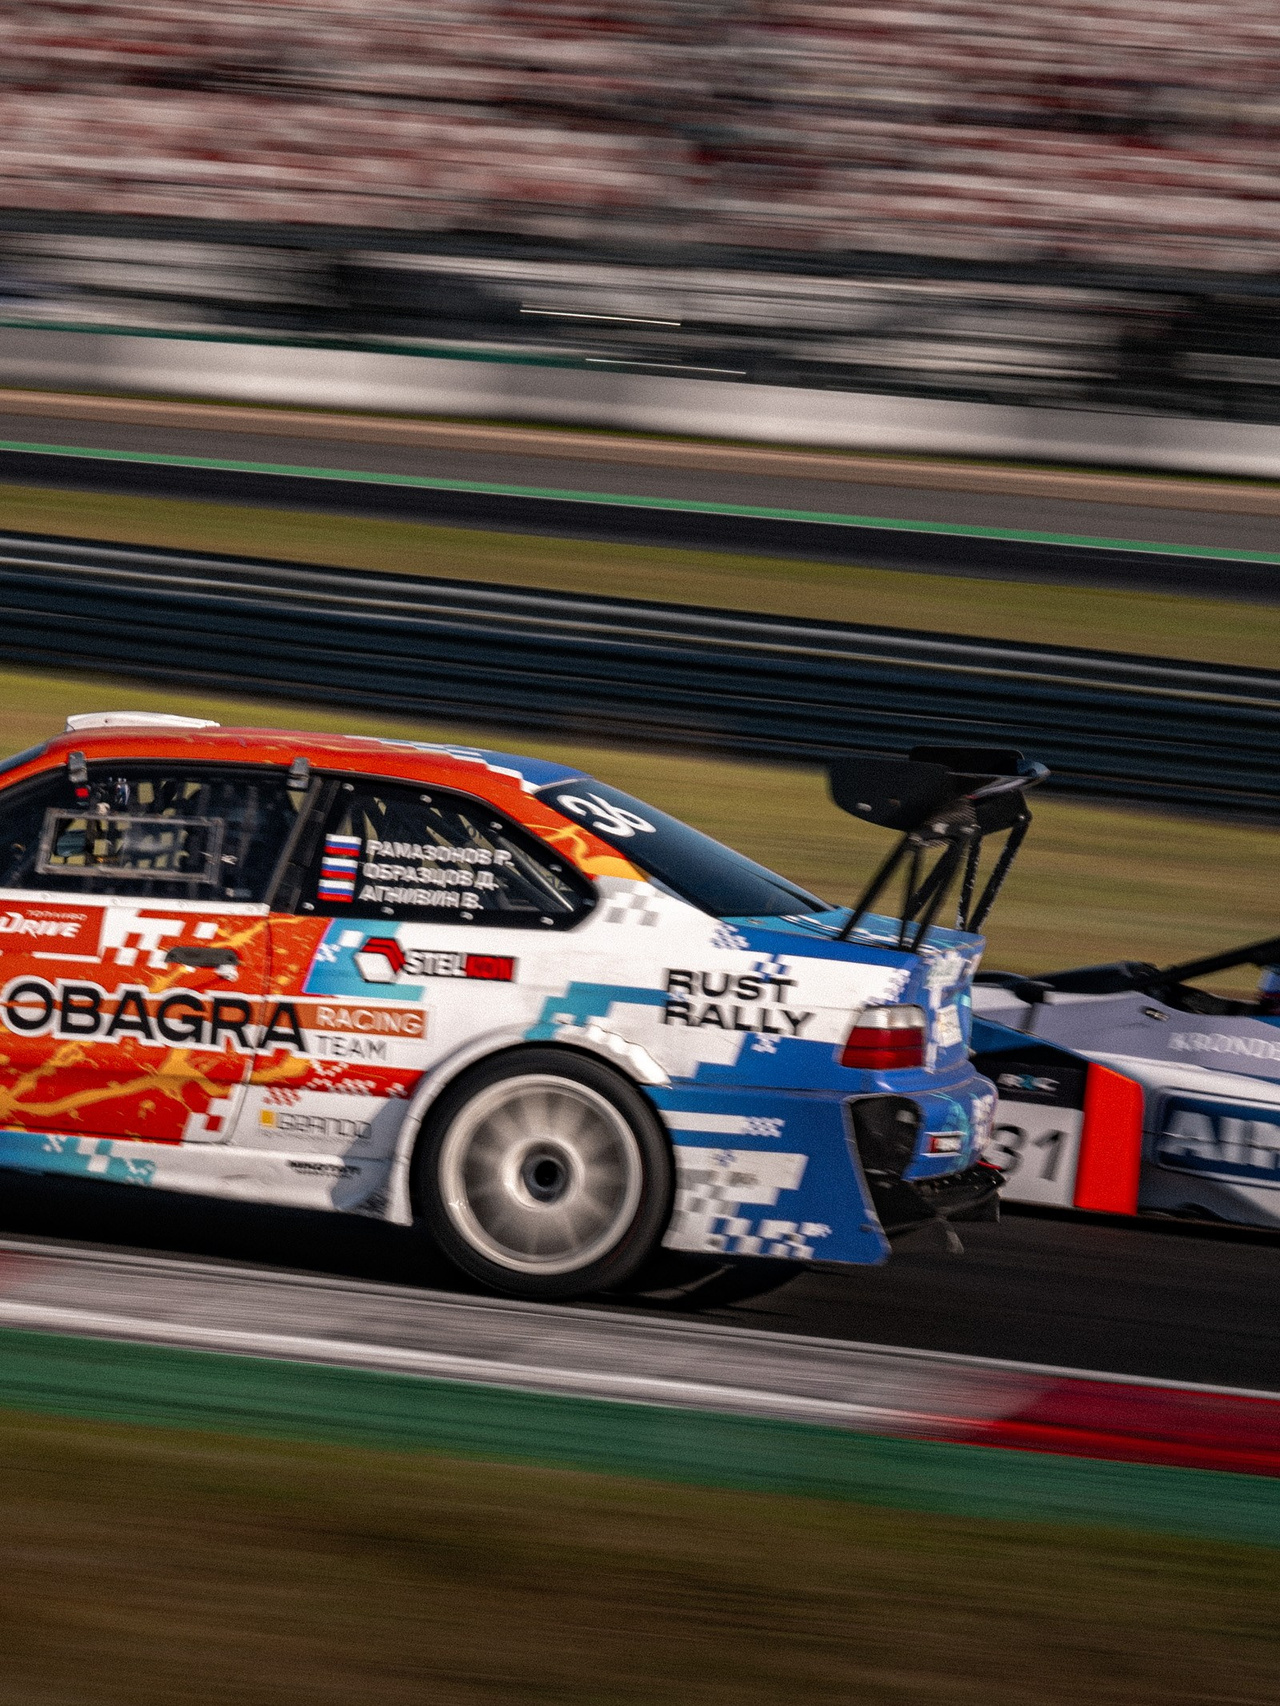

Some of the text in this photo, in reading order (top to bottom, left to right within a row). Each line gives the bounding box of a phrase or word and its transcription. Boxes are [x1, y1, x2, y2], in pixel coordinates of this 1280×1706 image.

[557, 792, 657, 838] 36
[362, 862, 474, 888] ОБРАЗЦОВ
[663, 968, 799, 1003] RUST
[6, 981, 310, 1054] OBAGRA
[317, 1006, 423, 1034] RACING
[661, 1000, 816, 1036] RALLY
[317, 1035, 388, 1061] TEAM
[989, 1122, 1069, 1182] 31
